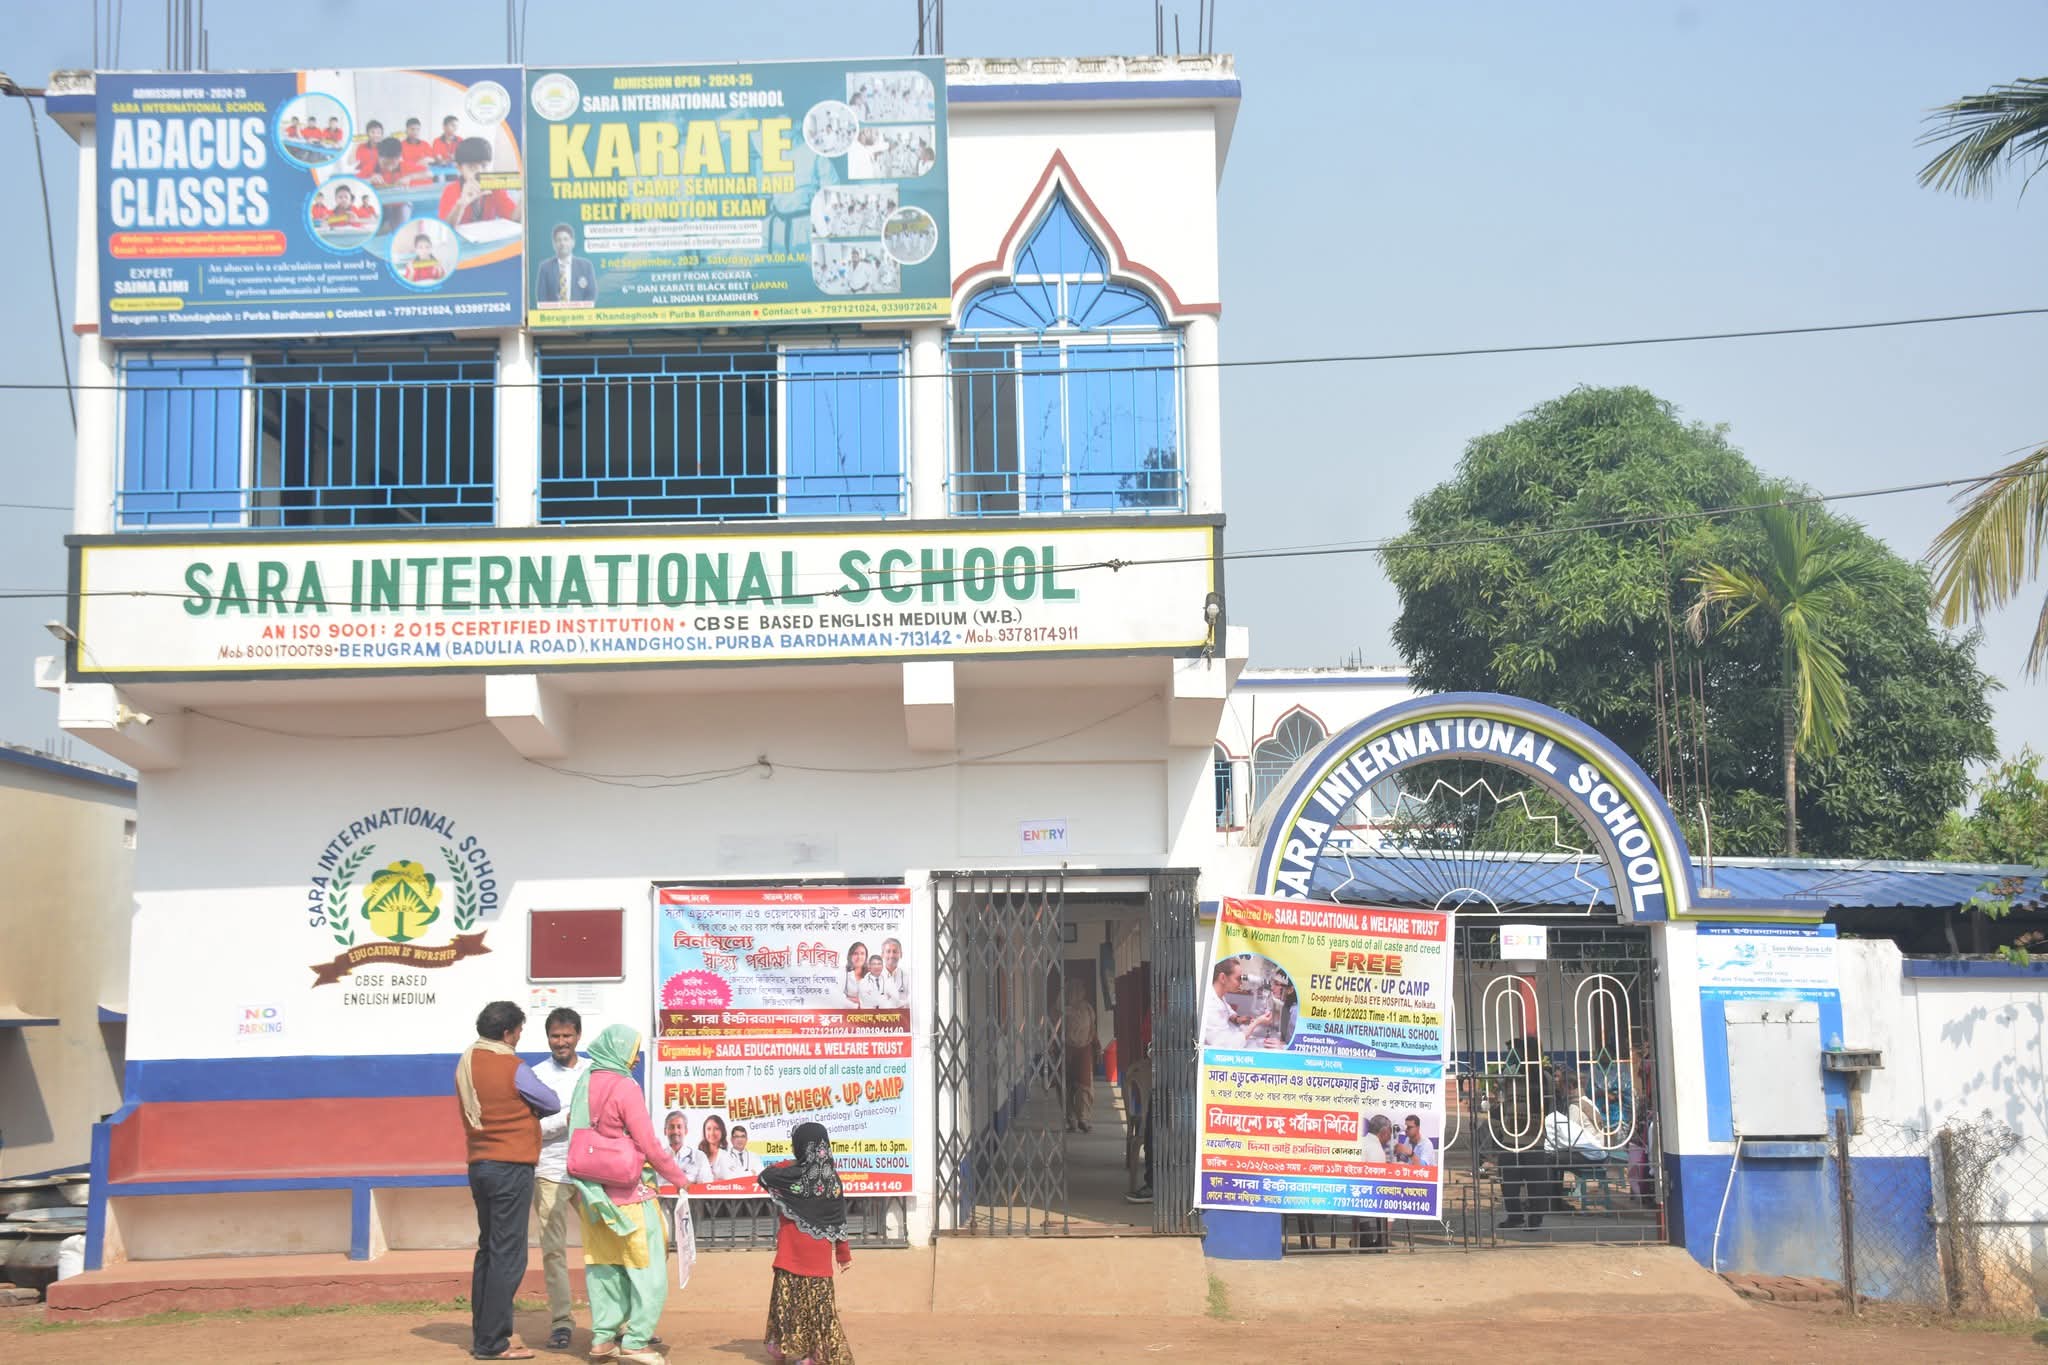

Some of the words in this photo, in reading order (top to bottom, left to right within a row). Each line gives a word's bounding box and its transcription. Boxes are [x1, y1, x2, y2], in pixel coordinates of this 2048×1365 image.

[613, 76, 673, 89] ADMISSION
[674, 76, 702, 88] OPEN
[708, 74, 753, 86] 2024-25
[112, 103, 139, 113] SARA
[142, 103, 223, 113] INTERNATIONAL
[226, 102, 267, 113] SCHOOL
[582, 96, 620, 112] SARA
[622, 92, 726, 111] INTERNATIONAL
[729, 90, 785, 108] SCHOOL
[111, 117, 267, 170] ABACUS
[548, 117, 795, 179] KARATE
[551, 181, 629, 199] TRAINING
[685, 176, 759, 195] SEMINAR
[761, 175, 796, 193] AND
[110, 175, 270, 228] CLASSES
[580, 203, 618, 221] BELT
[620, 200, 718, 221] PROMOTION
[722, 198, 767, 217] EXAM
[129, 267, 174, 280] EXPERT
[651, 272, 682, 282] EXPERT
[683, 272, 710, 281] FROM
[711, 271, 753, 280] KOLKATA
[636, 283, 658, 294] DAN
[659, 283, 696, 293] KARATE
[696, 282, 726, 292] BLACK
[727, 281, 750, 291] BELT
[652, 295, 668, 304] ALL
[670, 294, 701, 303] INDIAN
[702, 293, 759, 303] EXAMINERS
[335, 308, 373, 319] Contact
[183, 560, 328, 616] SARA
[351, 551, 815, 612] INTERNATIONAL
[838, 545, 1077, 603] SCHOOL
[262, 625, 285, 640] AN
[293, 624, 321, 639] ISO
[394, 622, 446, 637] 2015
[451, 620, 550, 637] CERTIFIED
[556, 618, 675, 634] INSTITUTION
[693, 616, 749, 631] CBSE
[759, 615, 813, 630] BASED
[819, 613, 894, 628] ENGLISH
[899, 611, 967, 627] MEDIUM
[972, 607, 1022, 626] (W.B.)
[445, 639, 525, 660] (BADULIA
[715, 635, 775, 650] PURBA
[1312, 718, 1558, 817] INTERNATIONAL
[1567, 762, 1665, 912] SCHOOL
[317, 806, 456, 872] INTERNATIONAL
[1023, 828, 1065, 841] ENTRY
[459, 835, 499, 917] SCHOOL
[308, 875, 330, 928] SARA
[1274, 907, 1298, 925] SARA
[1300, 910, 1360, 930] EDUCATIONAL
[1361, 915, 1369, 931] &
[1370, 915, 1409, 934] WELFARE
[1410, 919, 1440, 937] TRUST
[673, 930, 755, 951] বিনামূল্যে
[1241, 928, 1249, 939] &
[1251, 928, 1280, 943] Woman
[1282, 933, 1300, 945] from
[1307, 934, 1315, 946] to
[1316, 935, 1326, 946] 65
[1328, 938, 1349, 950] years
[1350, 938, 1363, 949] old
[1364, 938, 1373, 950] of
[1373, 939, 1383, 950] all
[1383, 942, 1403, 952] caste
[1404, 942, 1418, 953] and
[1419, 943, 1441, 955] creed
[1503, 935, 1544, 946] EXIT
[348, 945, 400, 963] EDUCATION
[402, 946, 412, 956] IS
[413, 949, 458, 961] WORSHIP
[796, 941, 840, 969] শিবির
[1330, 951, 1403, 976] FREE
[355, 975, 385, 987] CBSE
[391, 975, 428, 987] BASED
[1310, 974, 1333, 990] EYE
[1335, 976, 1373, 993] CHECK
[1381, 978, 1396, 994] UP
[1398, 980, 1431, 997] CAMP
[343, 993, 390, 1006] ENGLISH
[392, 992, 436, 1005] MEDIUM
[1311, 992, 1344, 1004] Co-operated
[1354, 994, 1368, 1005] DISA
[1369, 996, 1381, 1006] EYE
[1413, 999, 1437, 1010] Kolkata
[245, 1008, 277, 1019] NO
[692, 1013, 719, 1025] সারা
[1311, 1006, 1328, 1018] Date
[1368, 1009, 1385, 1022] Time
[1412, 1013, 1421, 1024] to
[1323, 1023, 1345, 1034] SARA
[1345, 1024, 1407, 1039] INTERNATIONAL
[1408, 1029, 1440, 1041] SCHOOL
[716, 1043, 742, 1057] SARA
[743, 1042, 812, 1057] EDUCATIONAL
[823, 1042, 869, 1056] WELFARE
[871, 1041, 904, 1055] TRUST
[664, 1066, 682, 1077] Man
[692, 1066, 724, 1077] Woman
[725, 1065, 744, 1077] from
[753, 1065, 762, 1076] to
[764, 1065, 775, 1076] 65
[778, 1066, 801, 1079] years
[803, 1064, 814, 1076] old
[818, 1064, 827, 1075] of
[829, 1064, 840, 1075] all
[841, 1065, 865, 1075] caste
[865, 1063, 881, 1075] and
[883, 1062, 907, 1074] creed
[1208, 1070, 1228, 1083] সারা
[1386, 1081, 1401, 1094] এর
[663, 1082, 727, 1109] FREE
[728, 1092, 784, 1121] HEALTH
[784, 1085, 833, 1114] CHECK
[842, 1081, 863, 1107] UP
[864, 1076, 904, 1103] CAMP
[1209, 1106, 1264, 1132] বিনামূল্যে
[1289, 1112, 1322, 1133] পরীক্ষা
[1323, 1113, 1358, 1134] শিবির
[766, 1142, 784, 1153] Date
[830, 1141, 849, 1152] Time
[880, 1141, 888, 1151] to
[875, 1156, 910, 1168] SCHOOL
[1231, 1178, 1259, 1190] সারা
[1349, 1184, 1374, 1198] স্কুল
[1333, 1196, 1378, 1209] 7797121024
[1383, 1199, 1431, 1212] 8001941140
